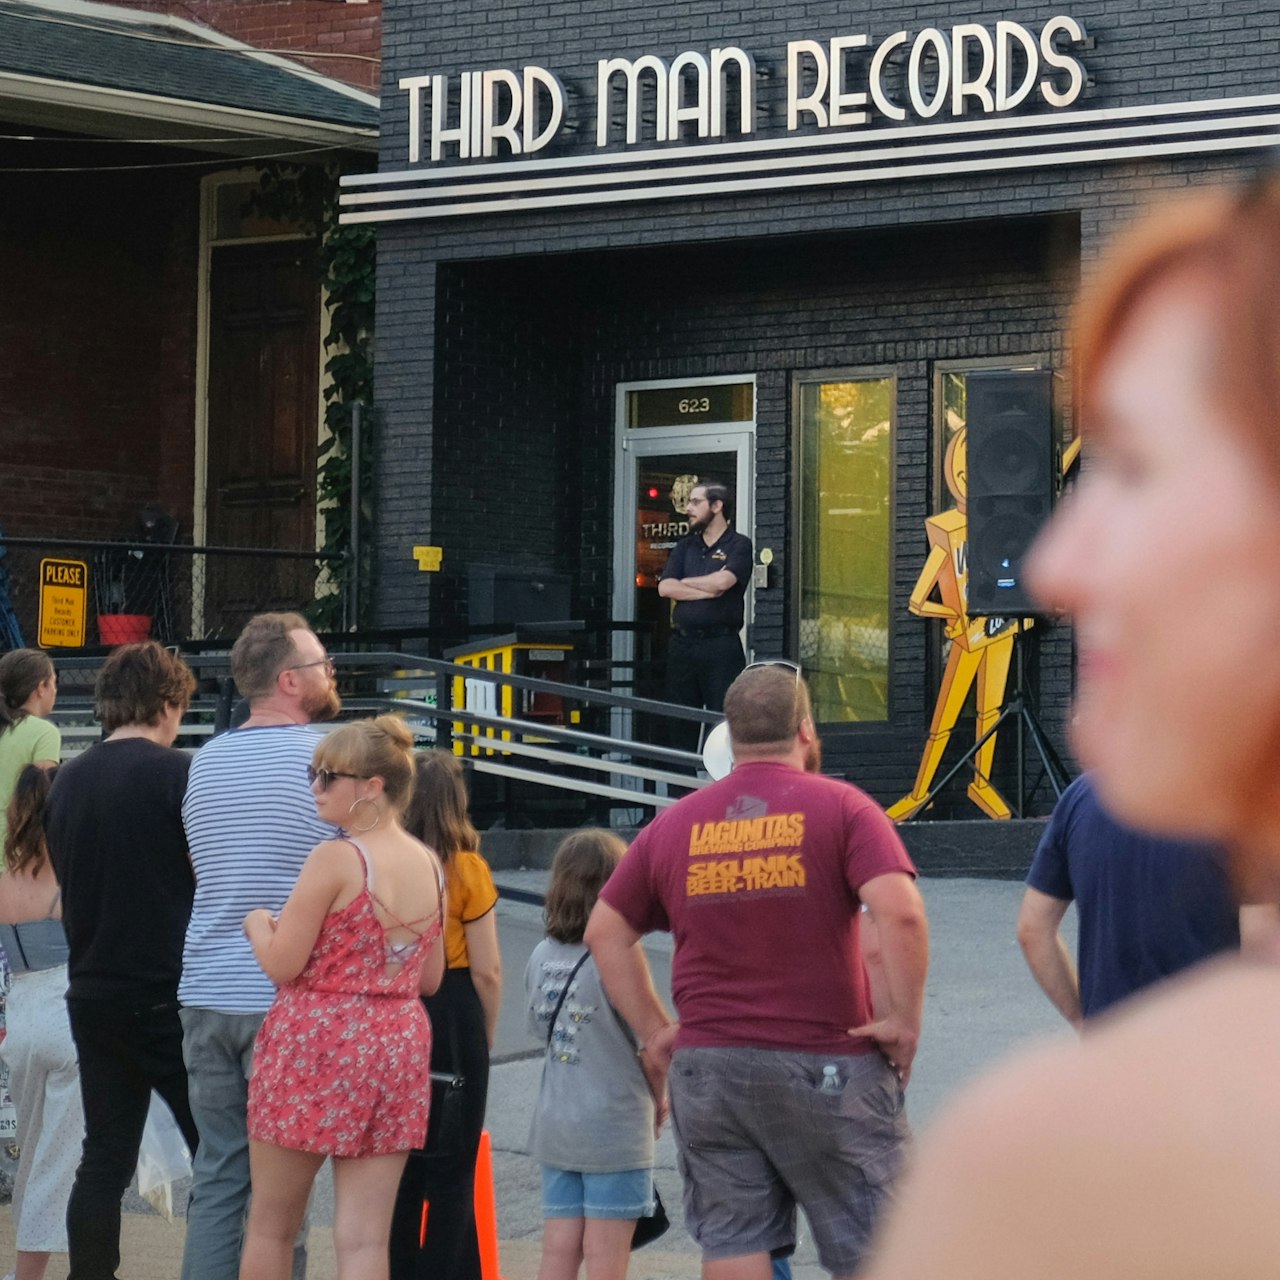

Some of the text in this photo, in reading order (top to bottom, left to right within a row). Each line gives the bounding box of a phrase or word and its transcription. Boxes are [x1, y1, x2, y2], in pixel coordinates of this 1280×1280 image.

[399, 15, 1090, 163] THIRD MAN RECORDS
[678, 397, 710, 414] 623
[642, 521, 690, 538] THIRD
[46, 565, 81, 585] PLEASE
[690, 813, 805, 846] LAGUNITAS
[687, 855, 803, 880] SKUNK
